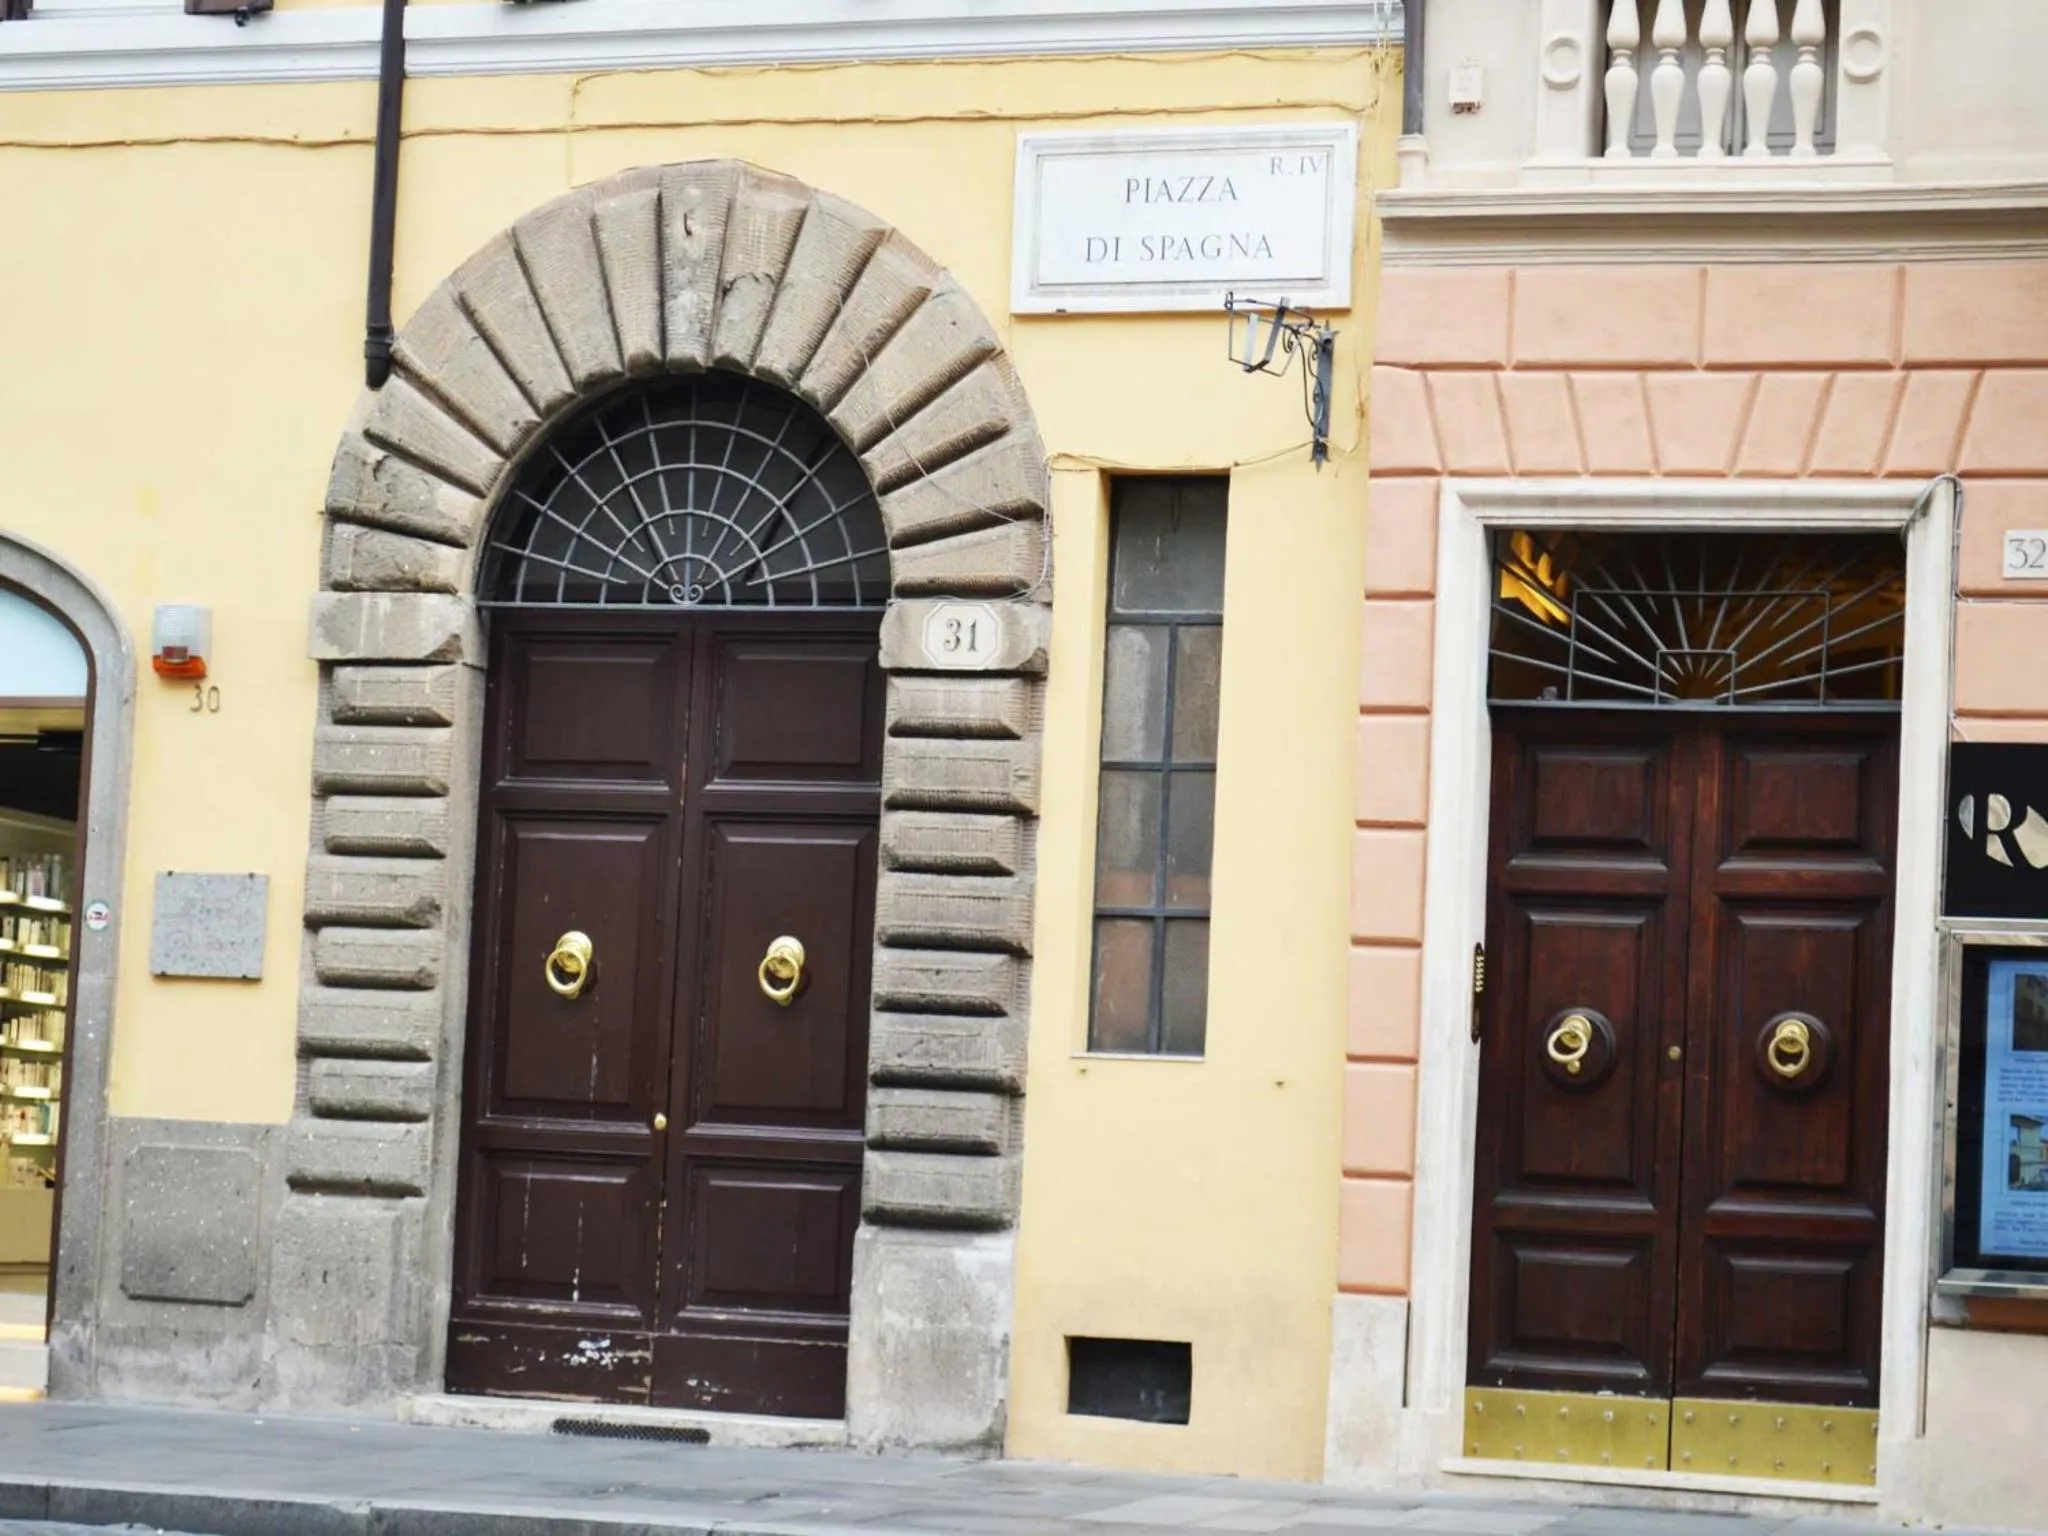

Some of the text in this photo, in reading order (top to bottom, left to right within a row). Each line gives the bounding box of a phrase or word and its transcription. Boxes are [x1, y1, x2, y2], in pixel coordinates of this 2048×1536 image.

[1125, 175, 1239, 204] PIAZZA
[1085, 233, 1273, 263] DI SPAGNA
[2009, 538, 2046, 570] 32
[943, 618, 978, 652] 31
[189, 684, 220, 713] 30
